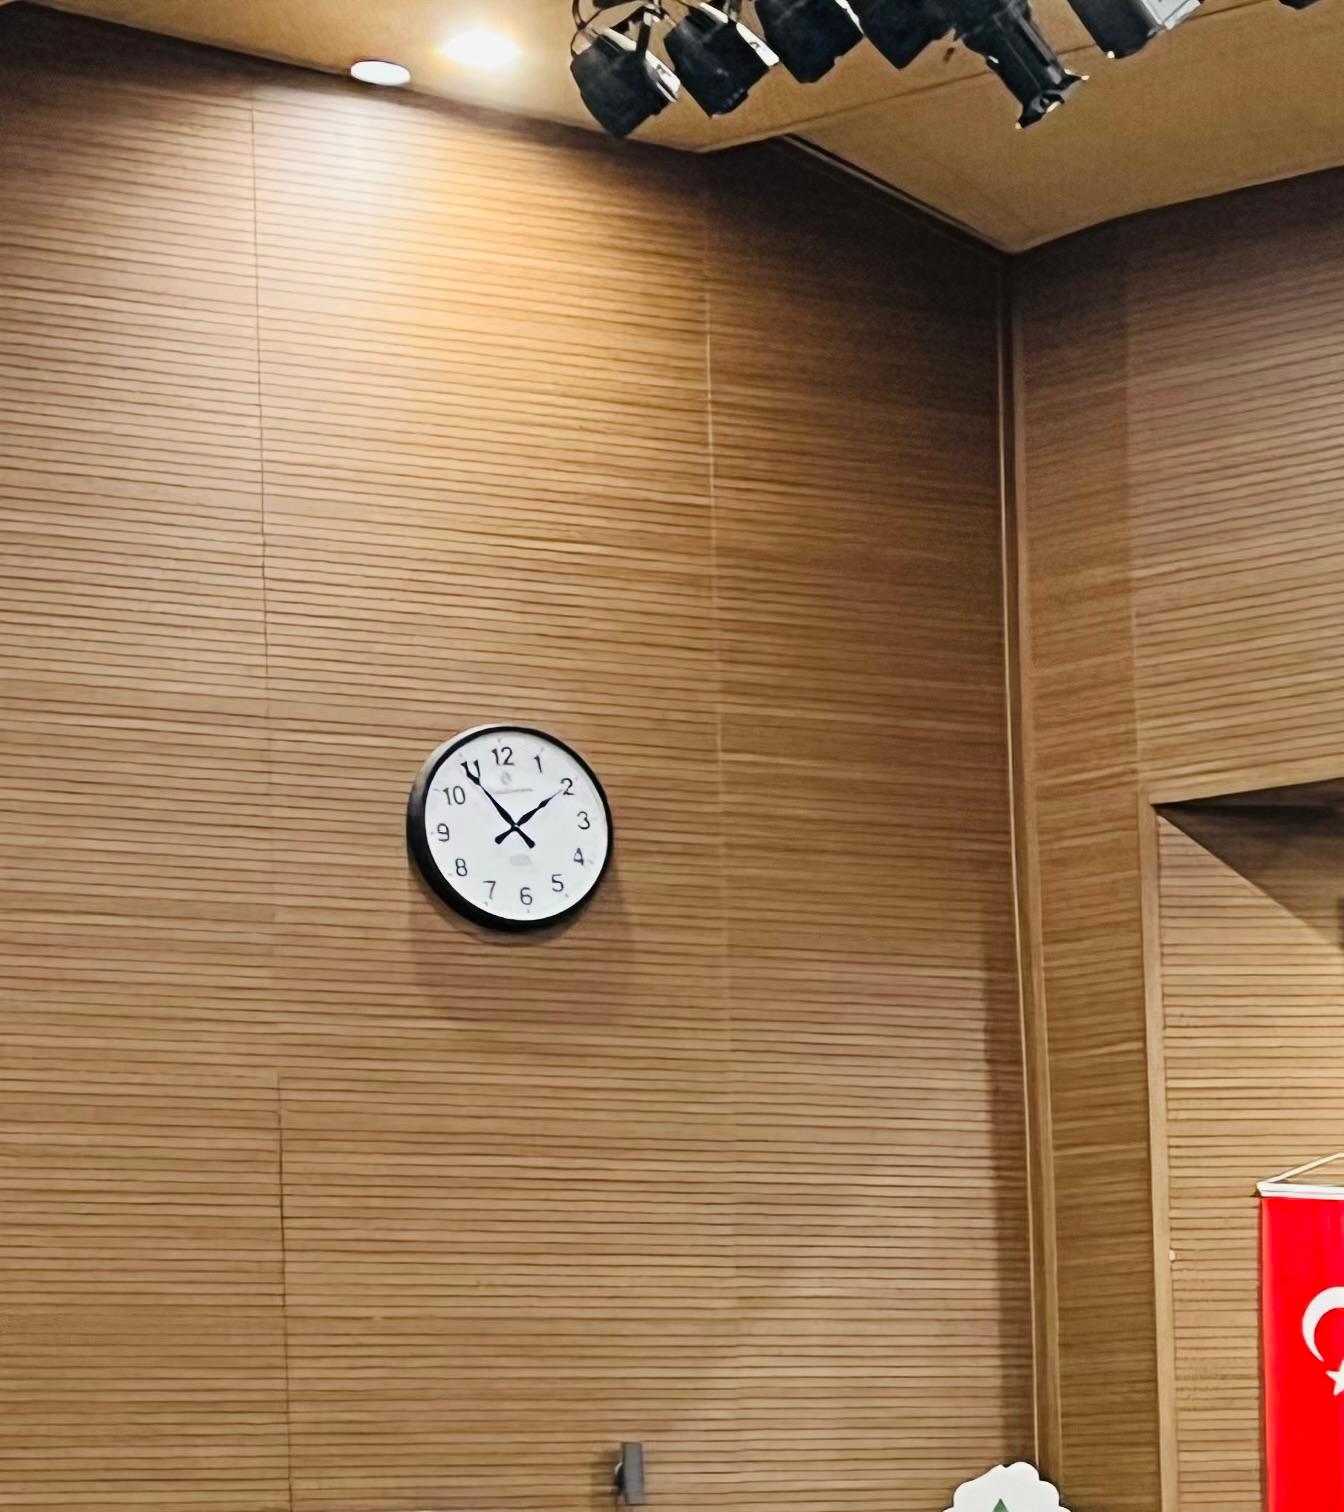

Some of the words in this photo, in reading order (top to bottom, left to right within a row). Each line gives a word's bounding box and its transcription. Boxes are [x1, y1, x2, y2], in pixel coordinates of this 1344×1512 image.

[491, 746, 515, 766] 12
[533, 755, 543, 773] 1
[443, 785, 466, 805] 10
[560, 777, 575, 796] 2
[576, 811, 591, 830] 3
[437, 823, 450, 842] 9
[573, 848, 584, 866] 4
[455, 858, 468, 877] 8
[483, 880, 496, 900] 7
[551, 874, 564, 893] 5
[519, 887, 533, 906] 6
